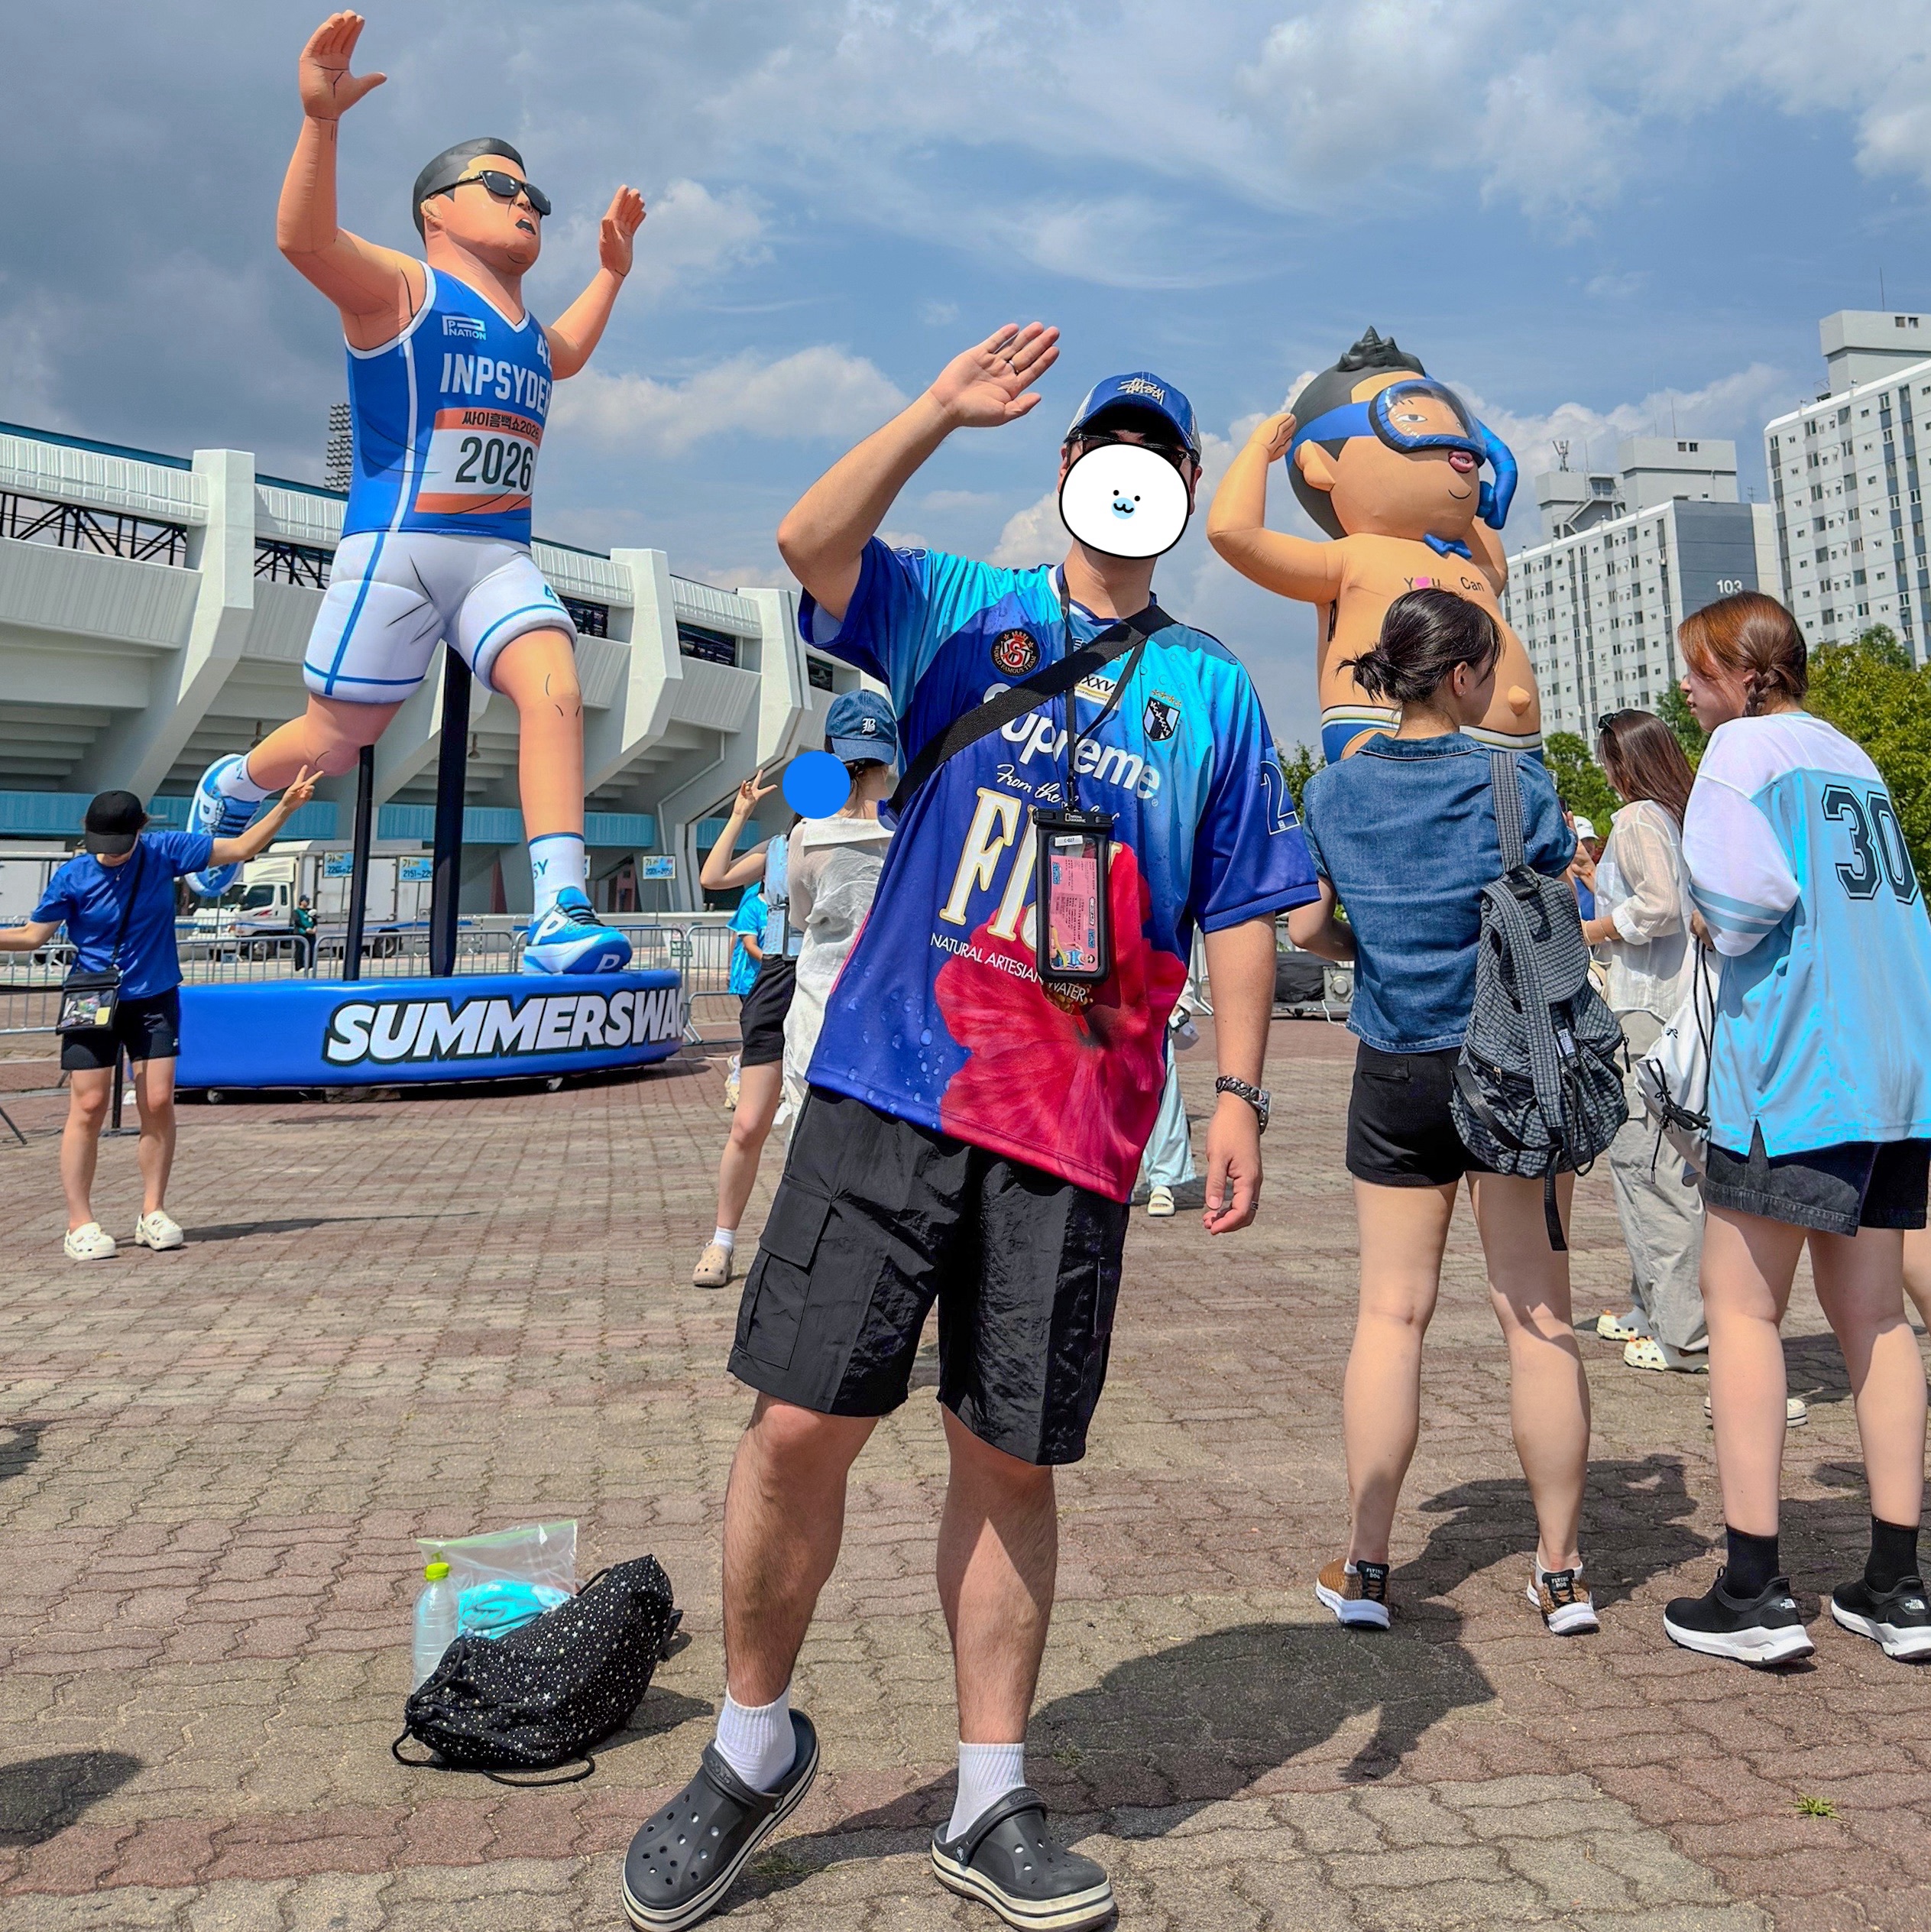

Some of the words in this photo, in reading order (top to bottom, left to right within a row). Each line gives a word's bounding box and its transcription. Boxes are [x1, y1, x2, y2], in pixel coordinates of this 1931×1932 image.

[449, 329, 487, 340] NATION
[455, 436, 533, 491] 2026
[1460, 577, 1485, 592] Can
[1716, 579, 1742, 595] 103
[1000, 664, 1025, 674] FAMOUS
[1023, 655, 1037, 670] TEAM
[996, 763, 1032, 793] From
[1035, 782, 1061, 802] the
[1822, 784, 1919, 906] 30
[930, 932, 983, 963] NATURAL
